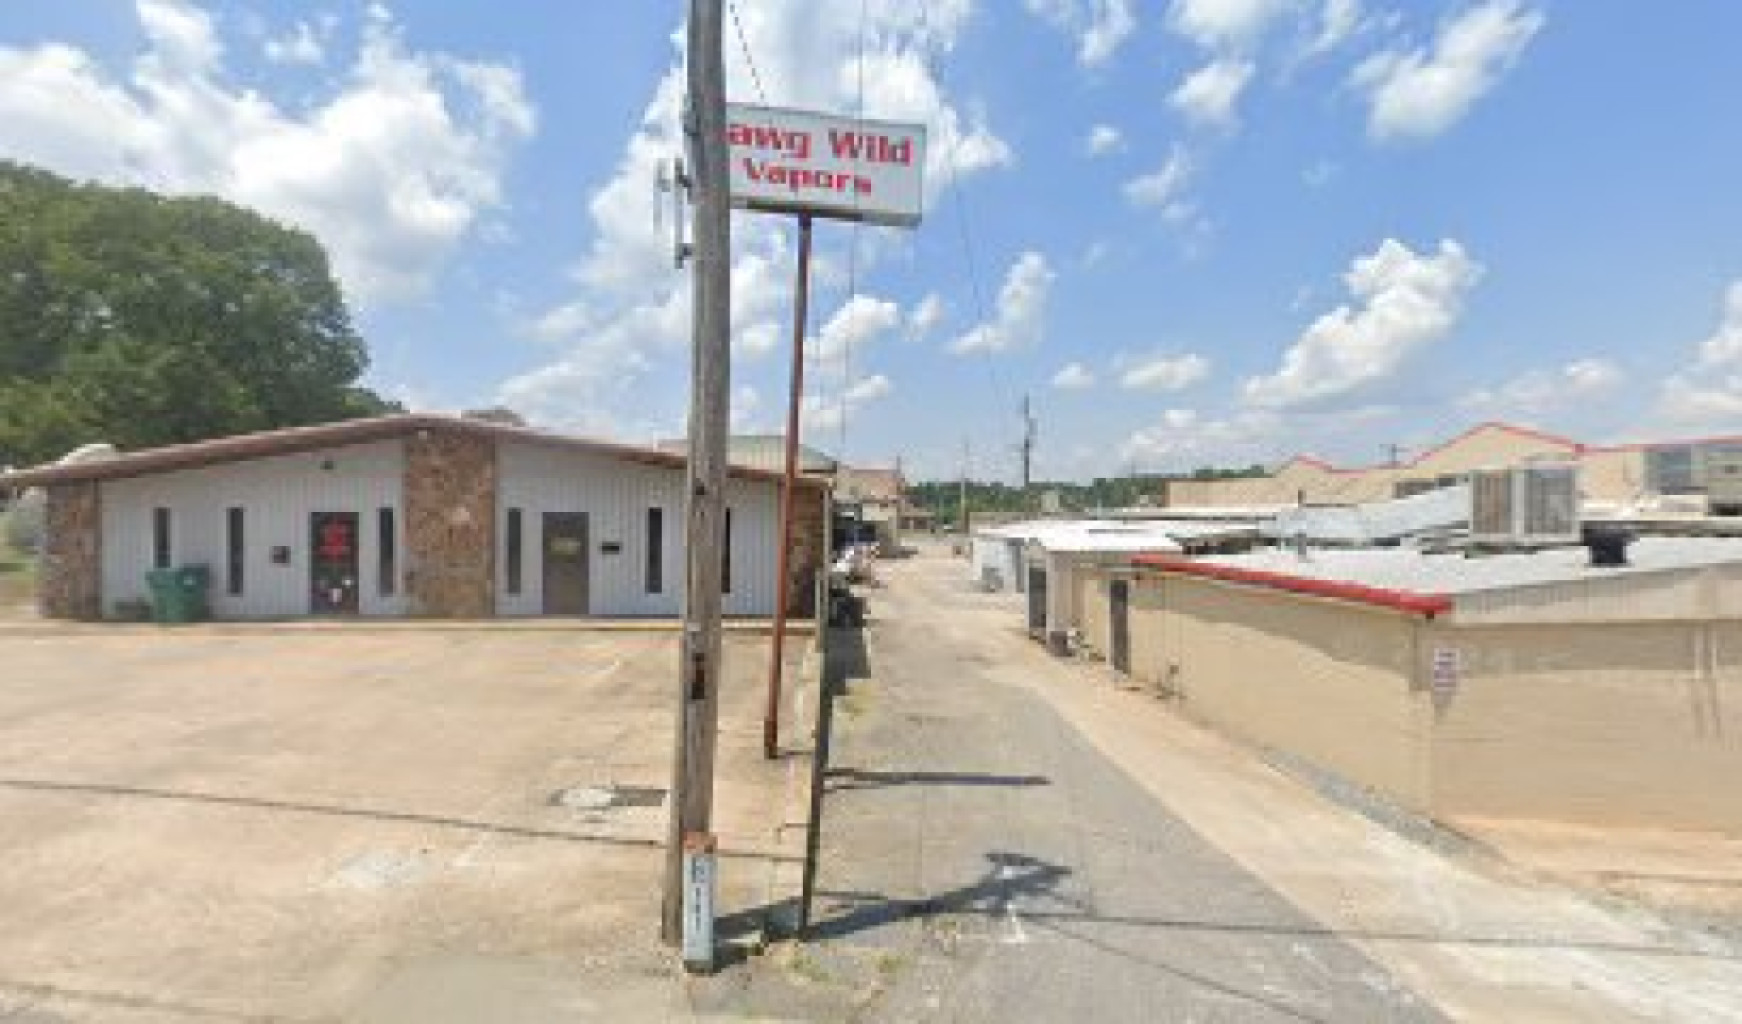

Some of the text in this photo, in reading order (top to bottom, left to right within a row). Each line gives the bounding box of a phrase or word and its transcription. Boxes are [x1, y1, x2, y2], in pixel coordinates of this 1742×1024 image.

[727, 124, 913, 166] awg Wild
[743, 157, 872, 195] Vapors
